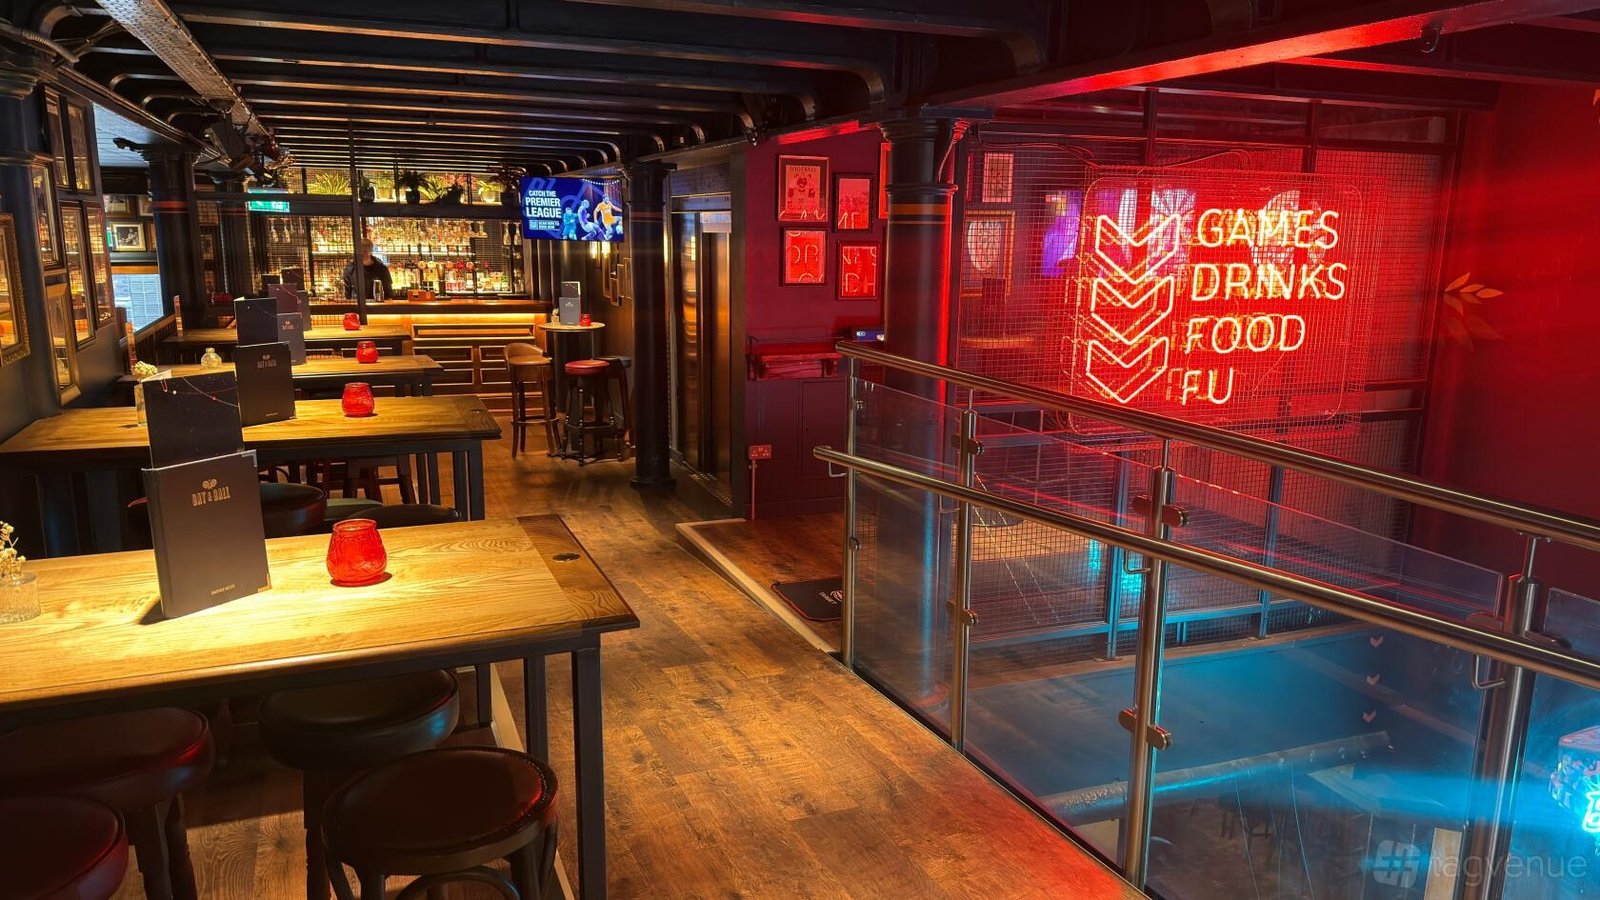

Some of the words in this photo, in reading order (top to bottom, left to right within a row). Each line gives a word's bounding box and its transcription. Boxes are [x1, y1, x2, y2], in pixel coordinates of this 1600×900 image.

[525, 197, 561, 207] PREMIER
[526, 207, 562, 218] LEAGUE
[1197, 208, 1339, 250] GAMES
[1191, 262, 1348, 301] DRINKS
[1184, 314, 1306, 355] FOOD
[1181, 366, 1234, 406] FU
[191, 492, 207, 507] BAT
[213, 486, 231, 502] BALL
